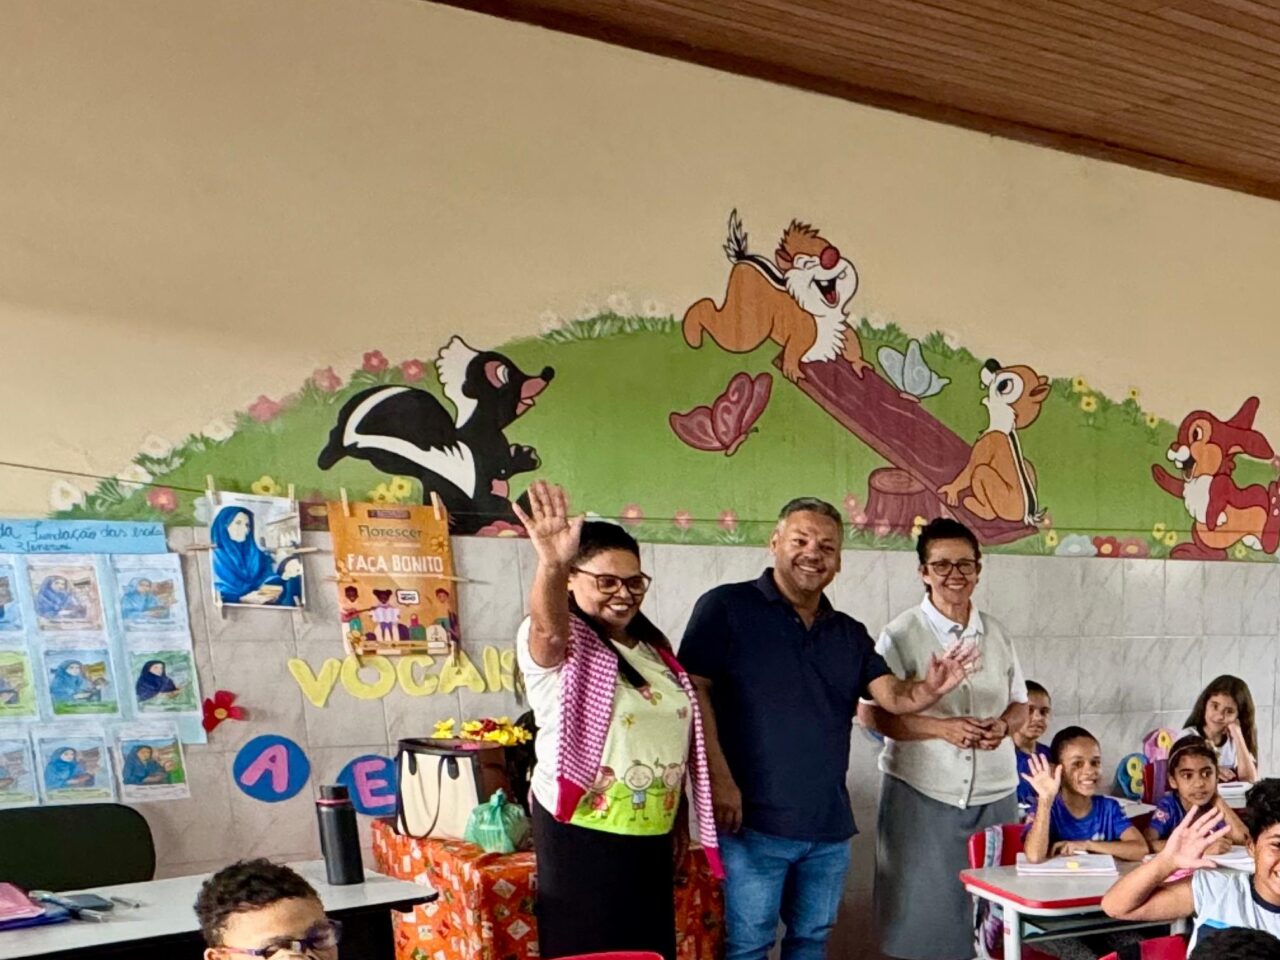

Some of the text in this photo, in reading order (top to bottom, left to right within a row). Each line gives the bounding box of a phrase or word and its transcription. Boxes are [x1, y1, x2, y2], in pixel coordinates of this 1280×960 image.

[358, 525, 423, 538] Florescer
[347, 553, 444, 573] FAÇA BONITO
[240, 744, 289, 793] A
[353, 759, 396, 808] E
